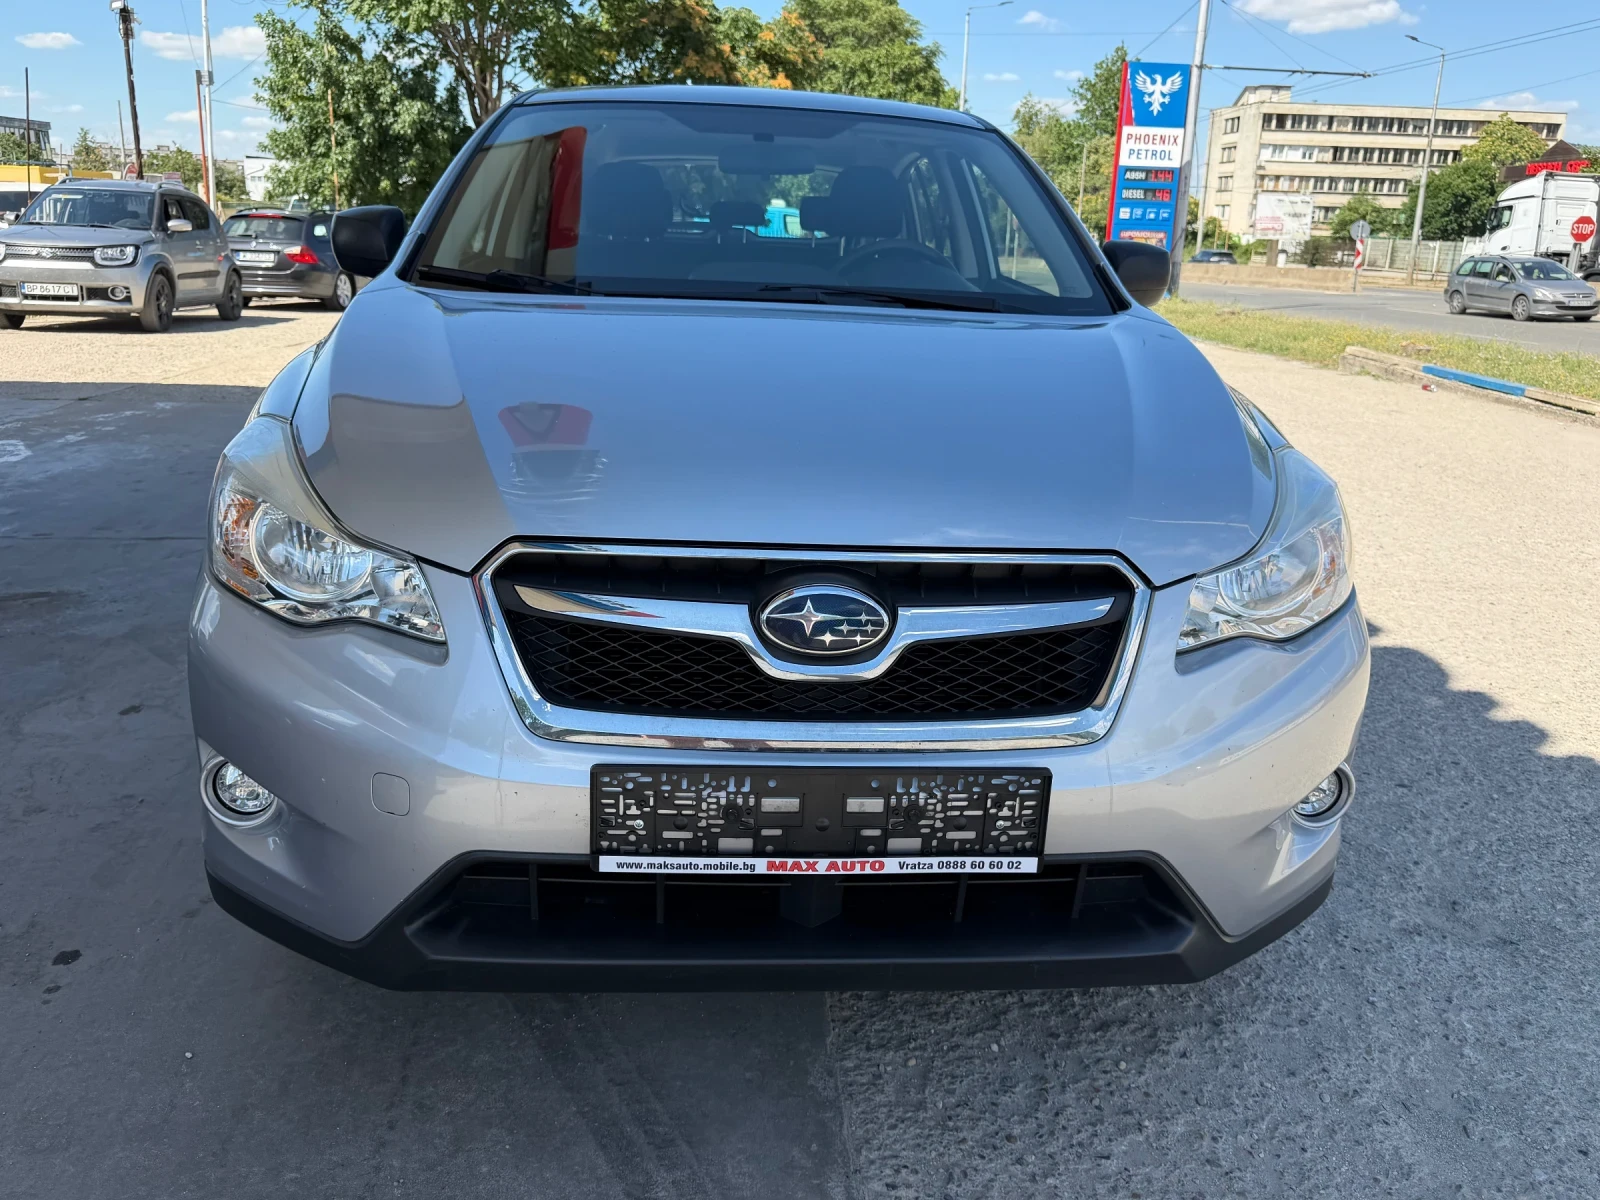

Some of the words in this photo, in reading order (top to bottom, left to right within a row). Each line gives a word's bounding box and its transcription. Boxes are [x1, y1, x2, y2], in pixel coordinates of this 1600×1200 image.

[1126, 133, 1179, 146] PHOENIX
[1128, 148, 1173, 161] PETROL
[1121, 188, 1145, 199] DIESEL
[1572, 223, 1595, 235] STOP
[26, 285, 38, 293] BP
[39, 285, 62, 294] 8617
[63, 285, 76, 294] CT
[616, 860, 756, 873] www.maksauto.mobile.bg
[766, 860, 820, 872] MAX
[825, 860, 885, 873] AUTO
[898, 860, 934, 871] Vratza
[937, 860, 967, 870] 0888
[970, 860, 985, 870] 60
[988, 860, 1004, 870] 60
[1007, 860, 1022, 870] 02
